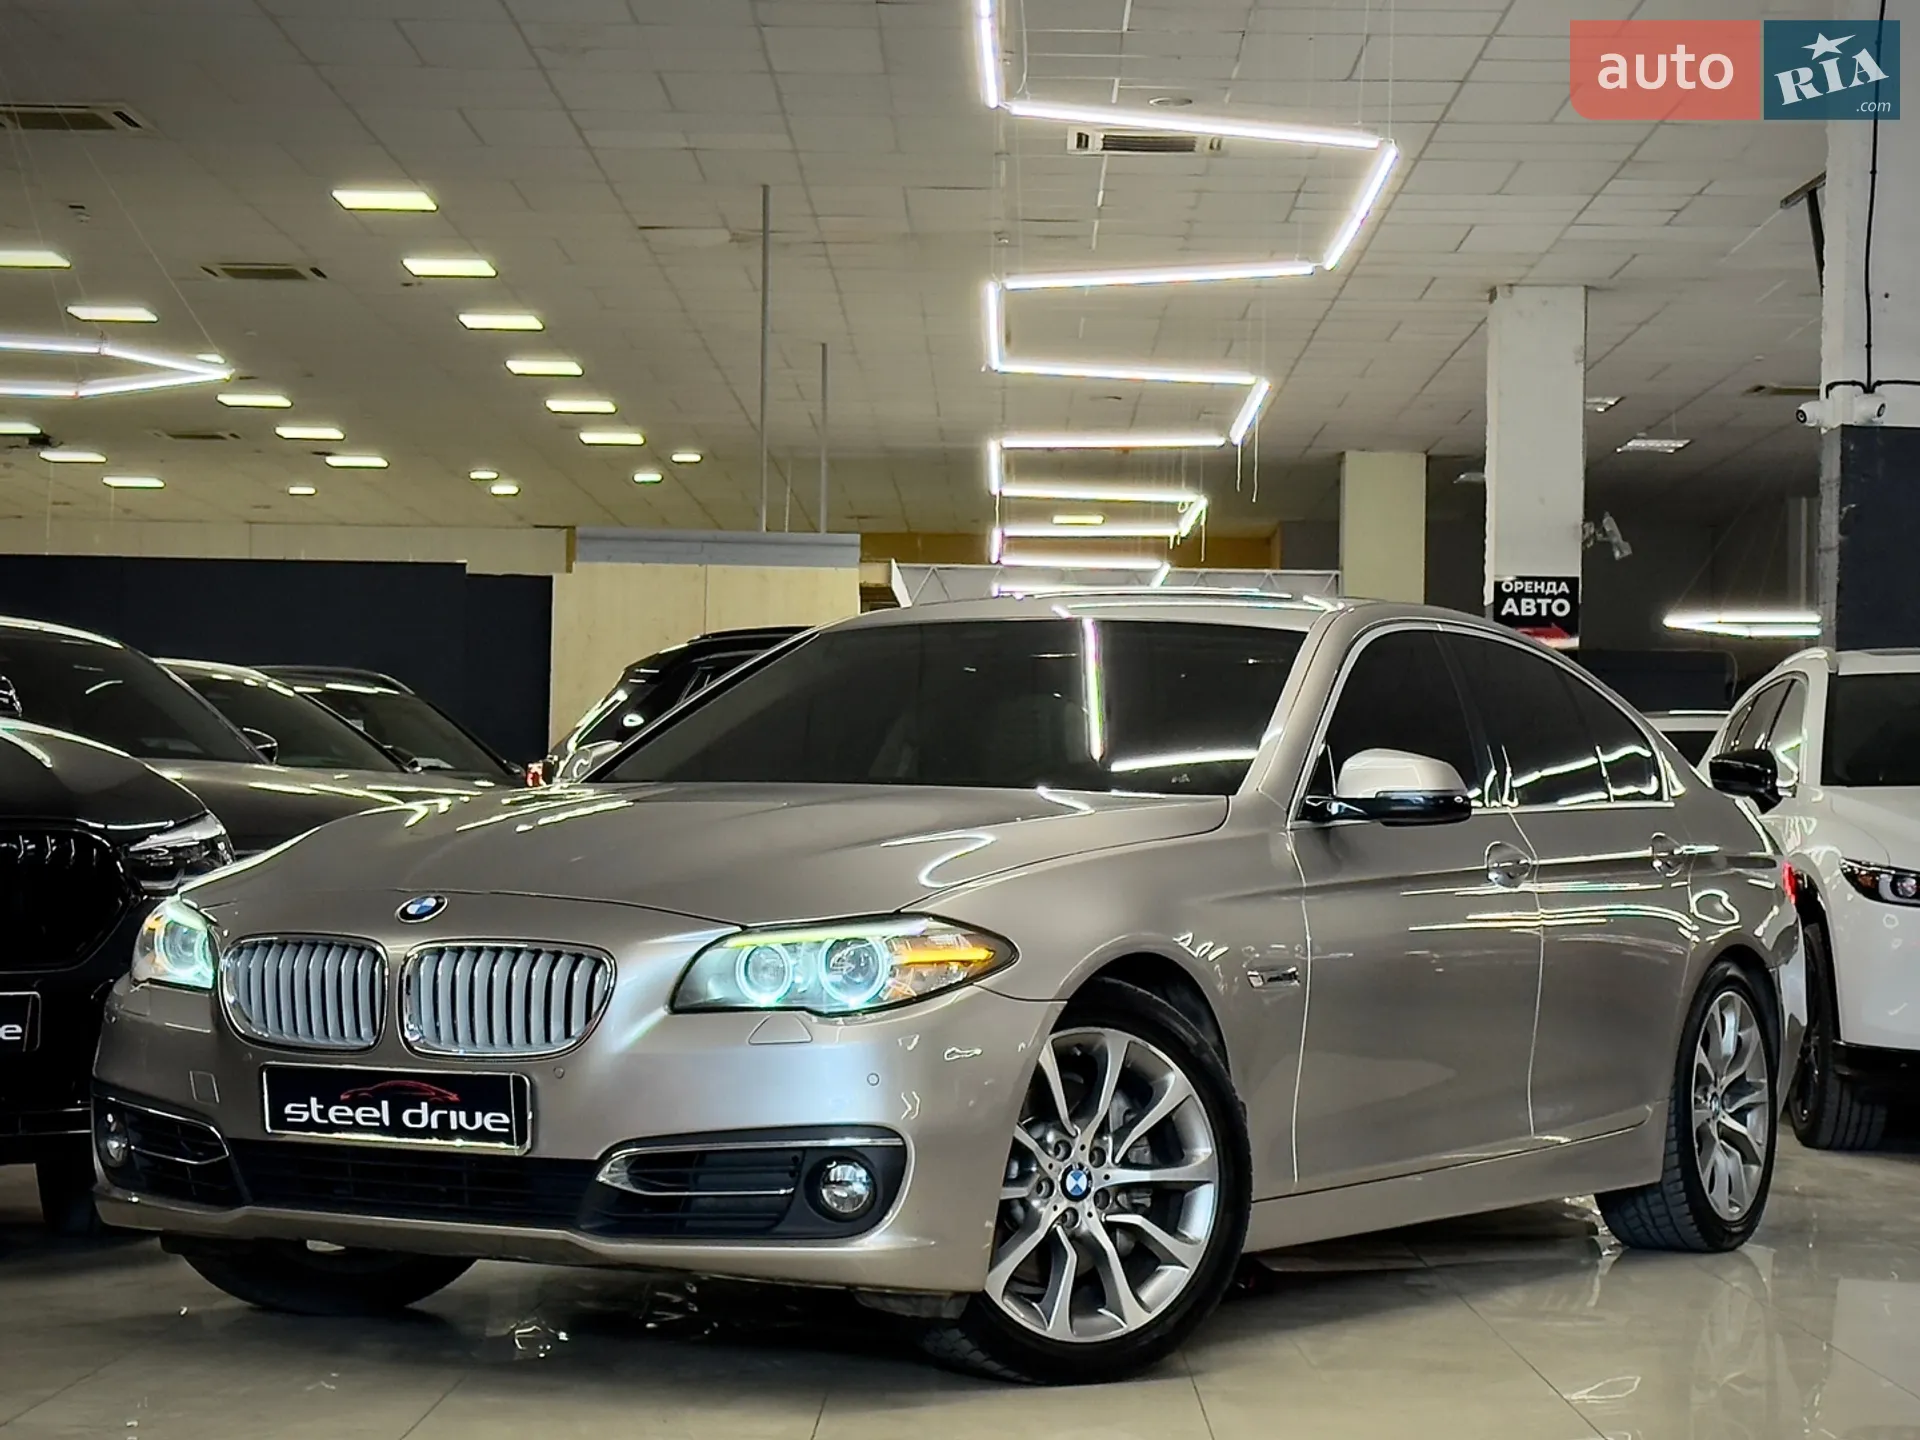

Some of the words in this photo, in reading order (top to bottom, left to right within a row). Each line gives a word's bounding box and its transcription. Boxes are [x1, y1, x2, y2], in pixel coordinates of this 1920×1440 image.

[1501, 581, 1570, 596] ОРЕНДА
[1501, 598, 1571, 617] АВТО
[284, 1097, 390, 1127] steel
[402, 1102, 511, 1132] drive
